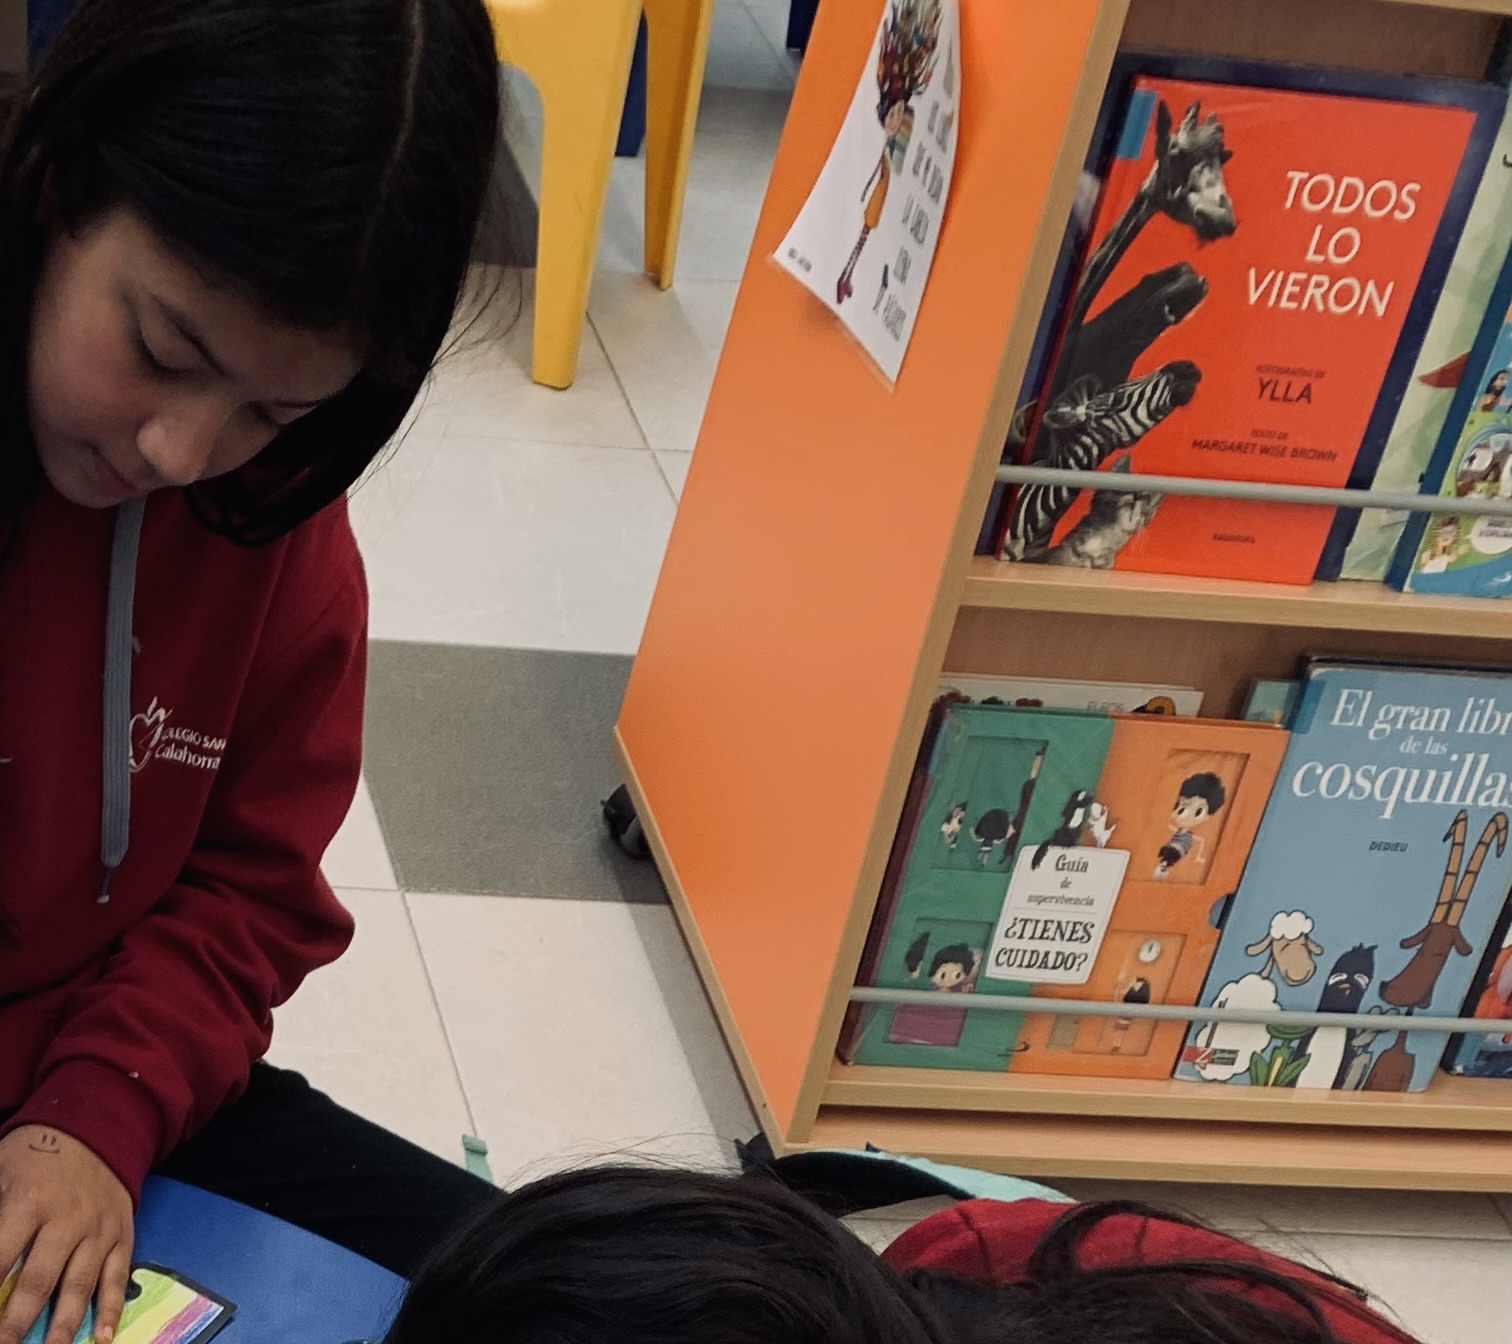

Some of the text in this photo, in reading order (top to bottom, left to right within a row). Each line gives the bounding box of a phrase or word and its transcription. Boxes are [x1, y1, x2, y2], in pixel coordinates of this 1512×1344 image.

[1285, 170, 1421, 220] TODOS
[1305, 223, 1361, 264] LO
[1248, 267, 1394, 317] VIERON
[1257, 378, 1313, 404] YLLA
[1192, 438, 1337, 462] MARGARET WISE BROWN
[1330, 688, 1373, 727] El
[1368, 703, 1451, 740] gran
[1399, 735, 1449, 755] de las
[1368, 840, 1409, 853] DEDIEU
[1054, 853, 1089, 873] Guía
[1060, 876, 1072, 889] de
[1027, 893, 1095, 907] supervivencia
[1004, 916, 1096, 945] ¿TIENES
[994, 947, 1088, 973] CUIDADO?
